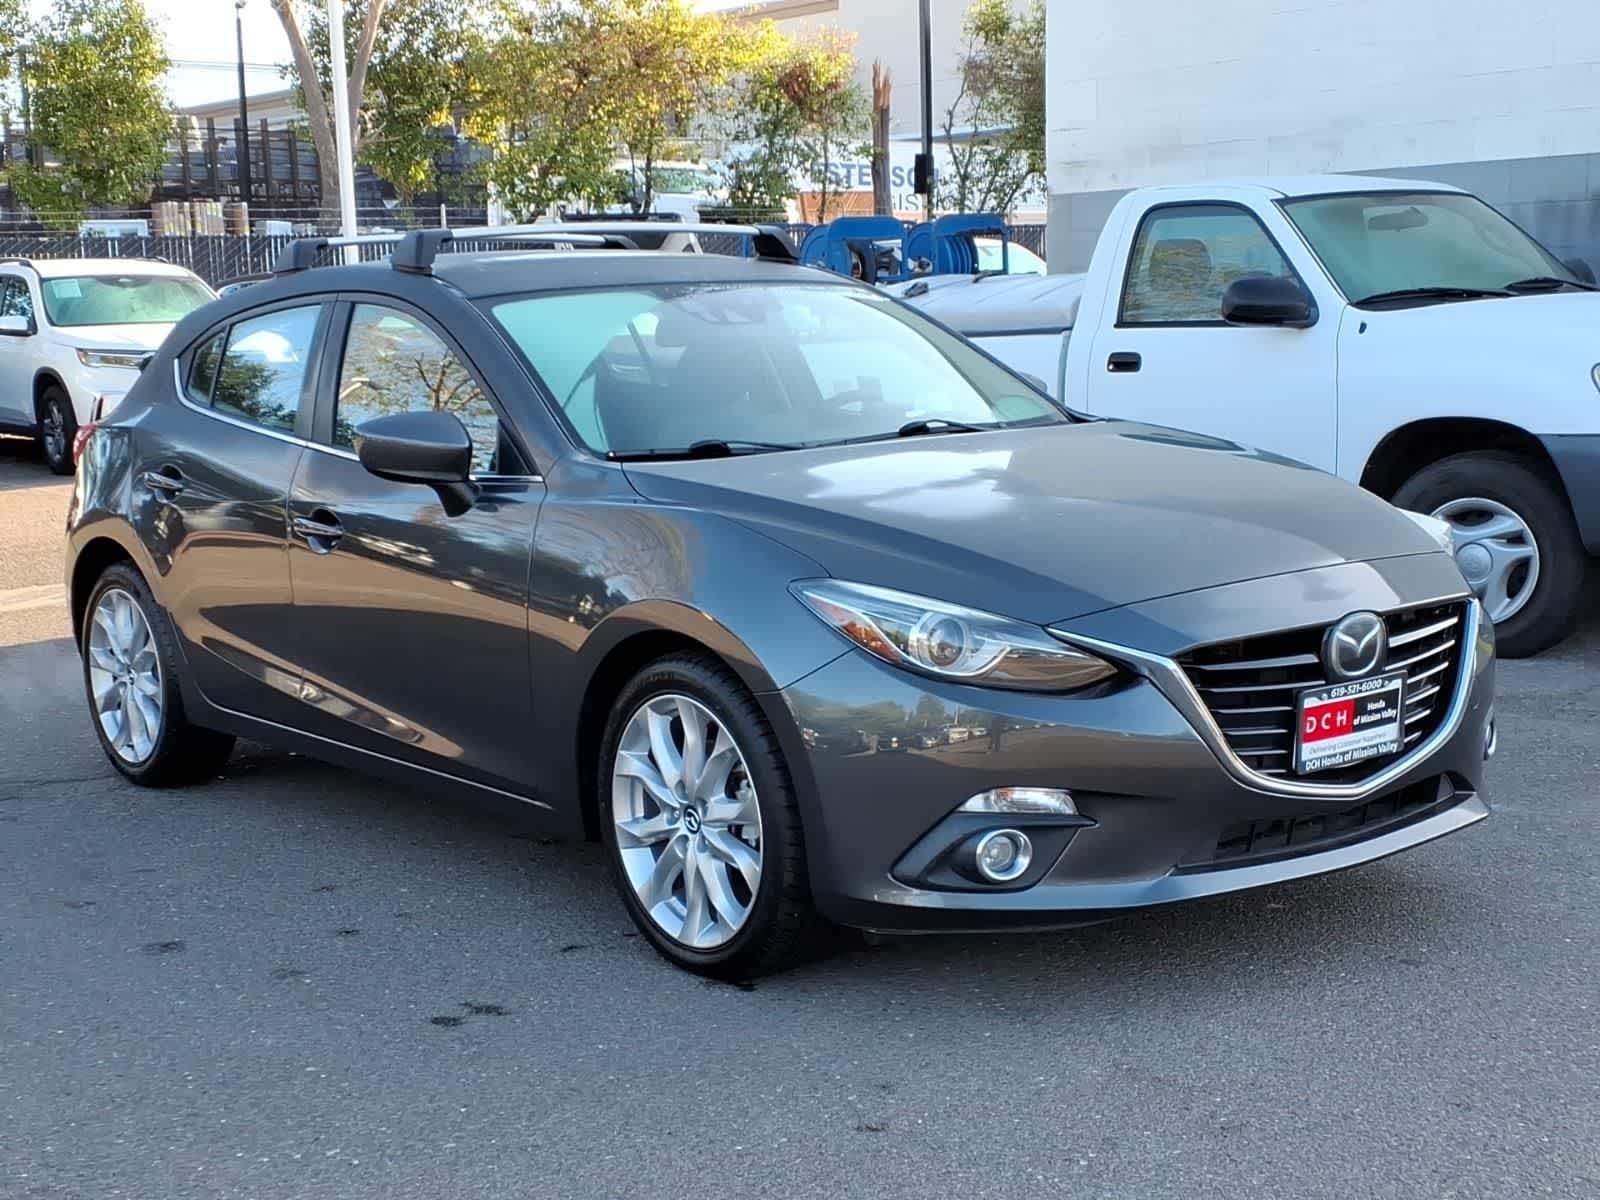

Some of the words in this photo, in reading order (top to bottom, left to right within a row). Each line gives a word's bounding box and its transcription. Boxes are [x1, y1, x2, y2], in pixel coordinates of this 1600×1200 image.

[1331, 679, 1383, 697] 619-521-6000
[1367, 699, 1386, 711] Honda
[1353, 715, 1361, 726] of
[1360, 711, 1381, 724] Mission
[1381, 708, 1397, 719] Valley
[1305, 760, 1321, 771] DCH
[1321, 754, 1343, 768] Honda
[1344, 752, 1353, 761] of
[1352, 747, 1378, 760] Mission
[1378, 742, 1399, 753] Valley
